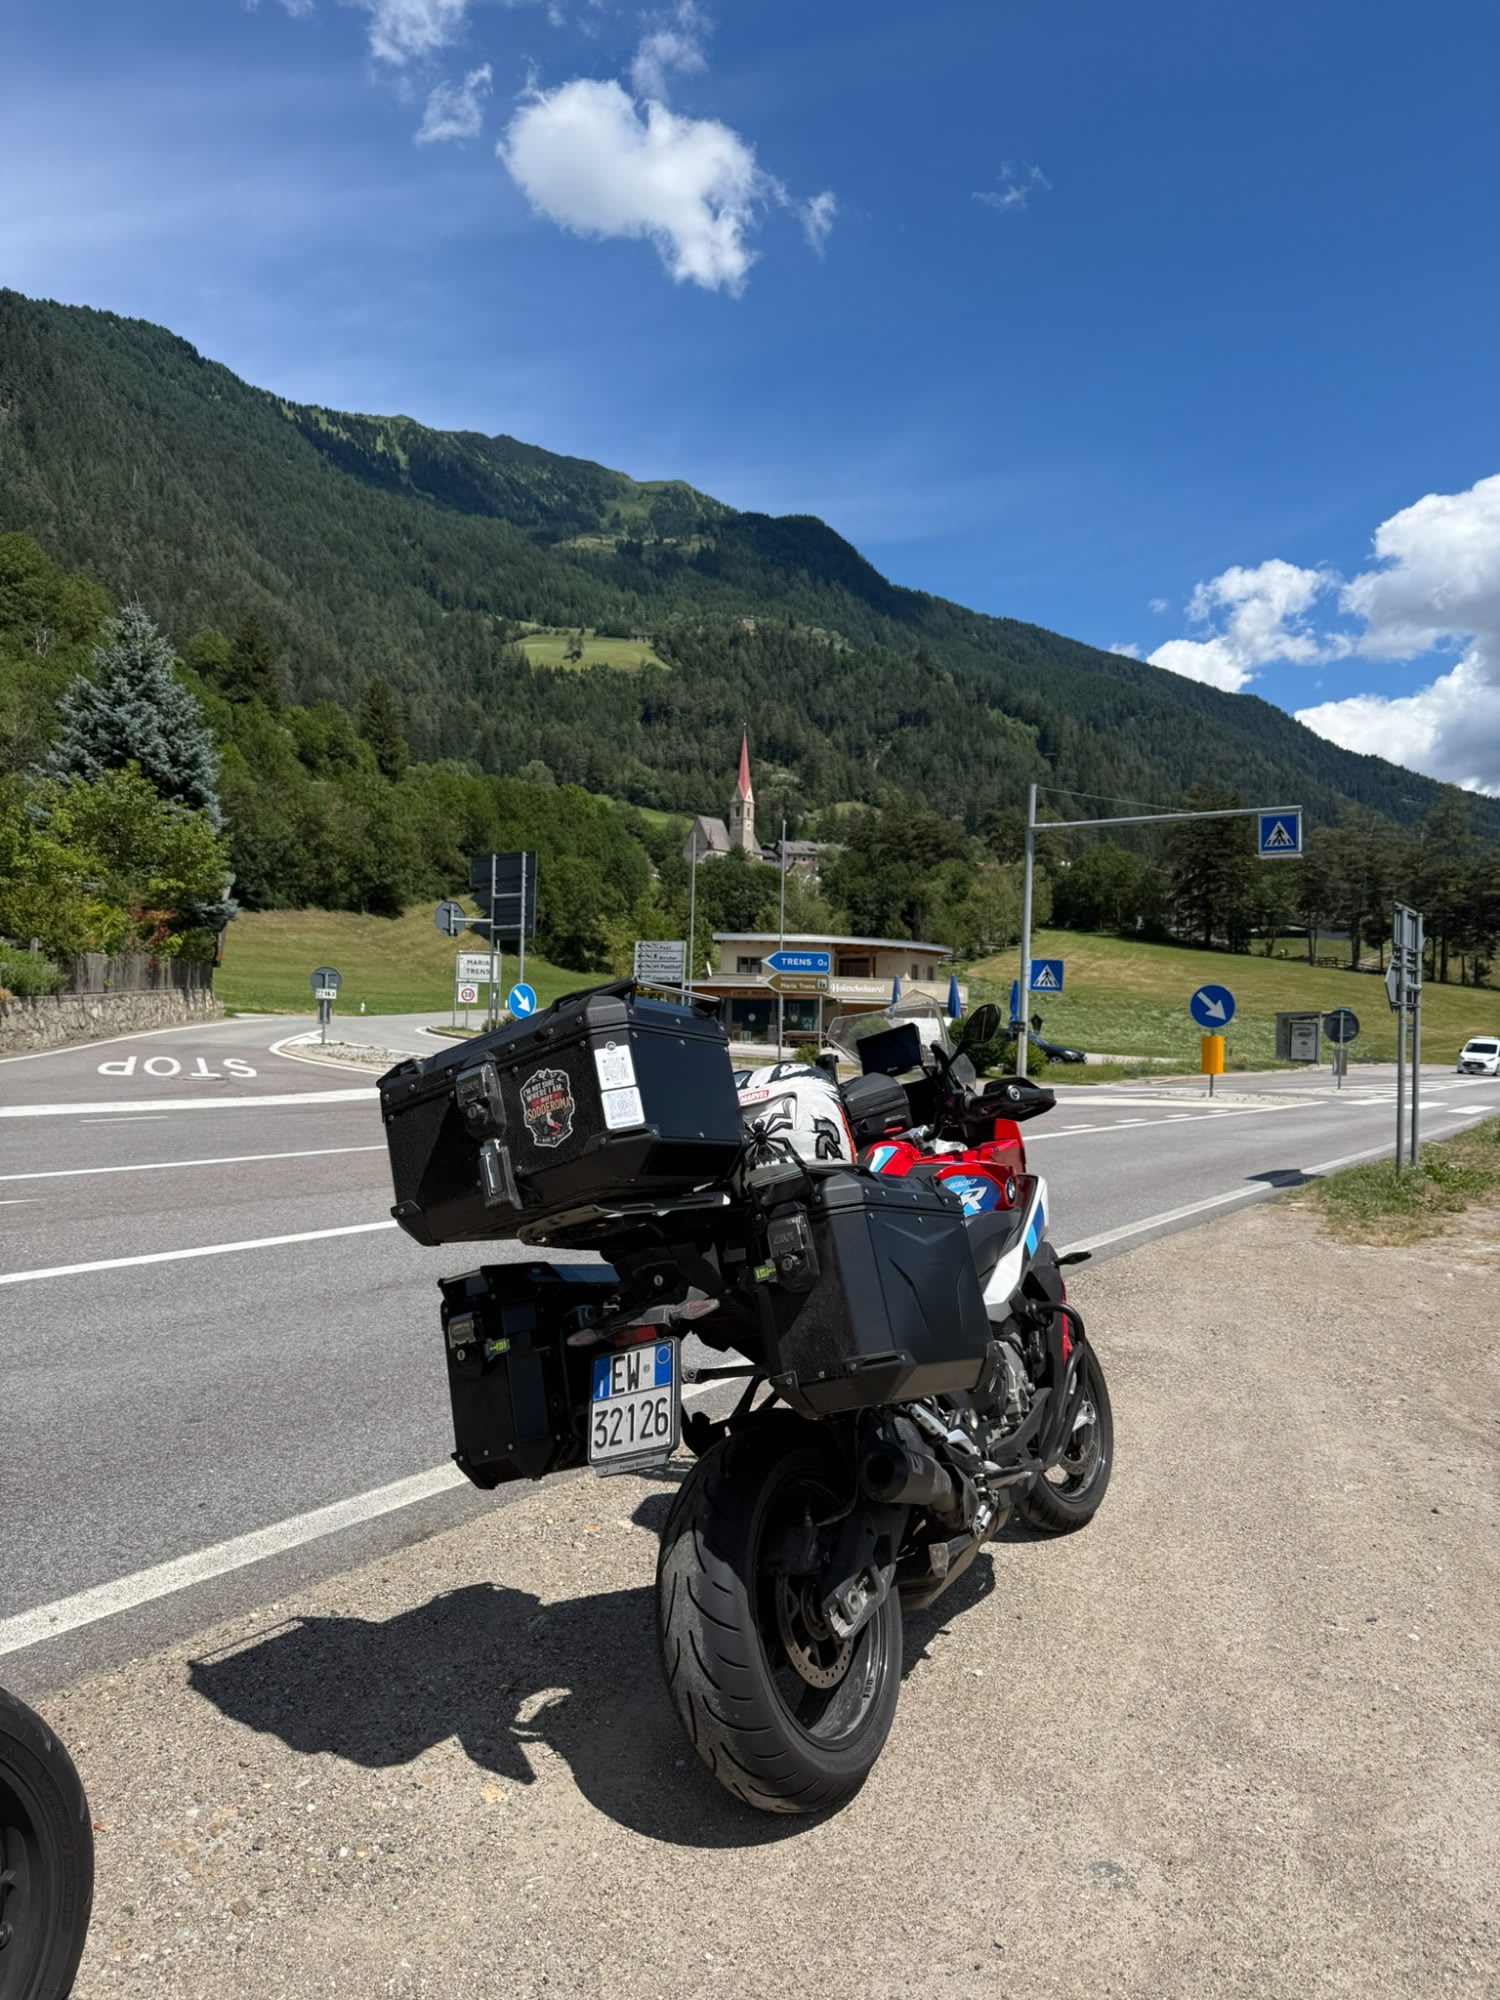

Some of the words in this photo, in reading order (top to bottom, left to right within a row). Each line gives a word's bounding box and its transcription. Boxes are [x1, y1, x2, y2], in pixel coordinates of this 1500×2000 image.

[781, 957, 812, 966] TRENS
[97, 1056, 258, 1078] STOP
[526, 1088, 547, 1102] WHERE
[740, 1090, 769, 1103] MARVEL
[612, 1352, 640, 1395] EW
[594, 1397, 668, 1449] 32126
